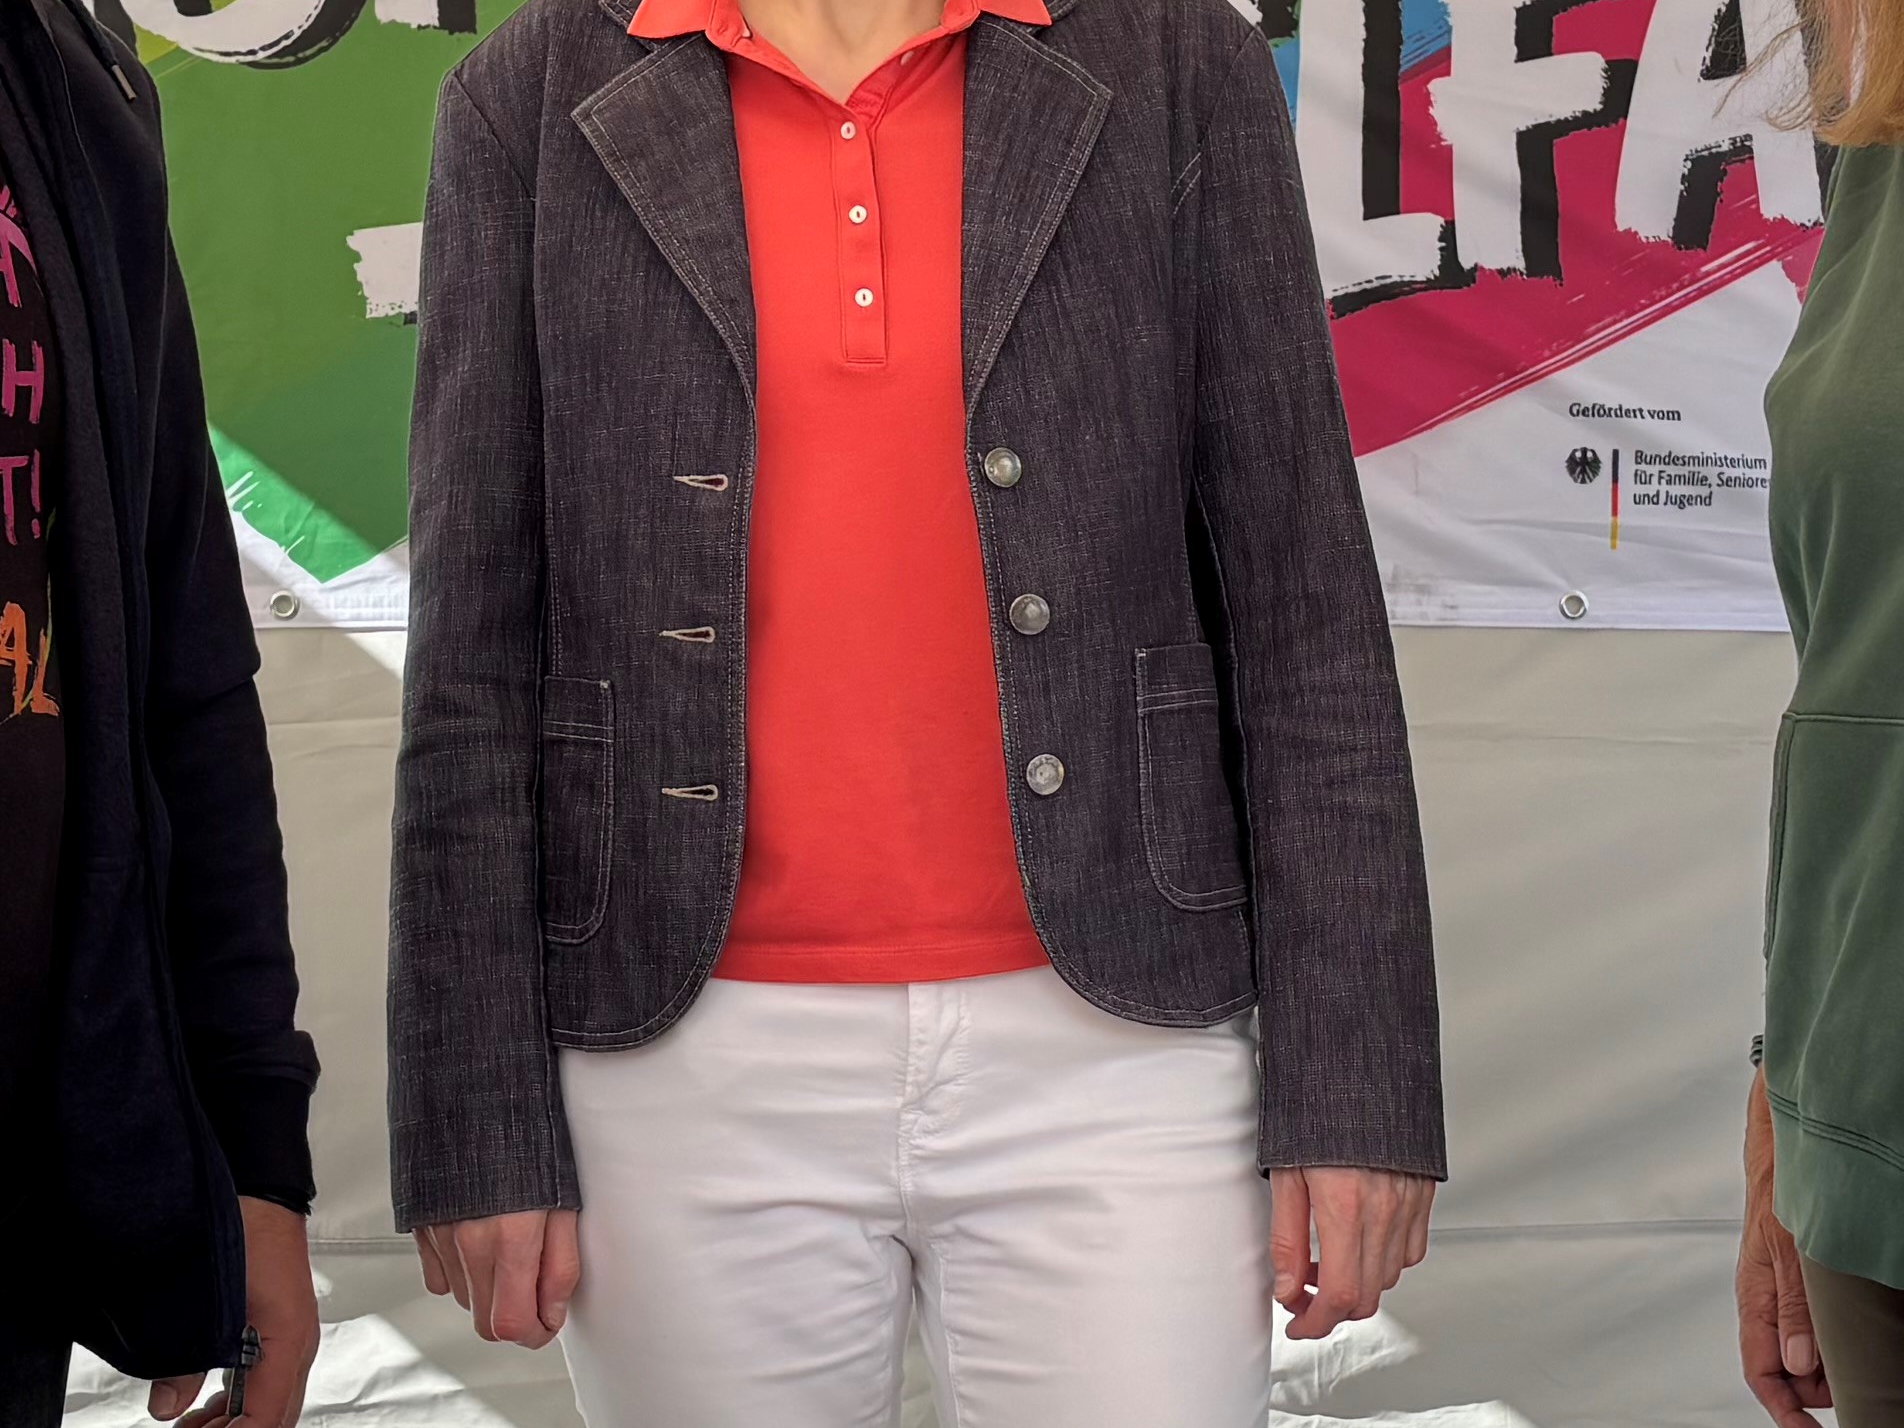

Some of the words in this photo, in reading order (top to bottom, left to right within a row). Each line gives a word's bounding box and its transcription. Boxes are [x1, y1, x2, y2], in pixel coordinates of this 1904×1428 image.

[1568, 402, 1645, 420] Gefördert
[1647, 408, 1682, 422] vom
[1633, 449, 1768, 471] Bundesministerium
[1633, 470, 1656, 486] für
[1657, 470, 1713, 490] Familie,
[1715, 471, 1770, 490] Seniore
[1633, 489, 1660, 506] und
[1662, 490, 1713, 510] Jugend
